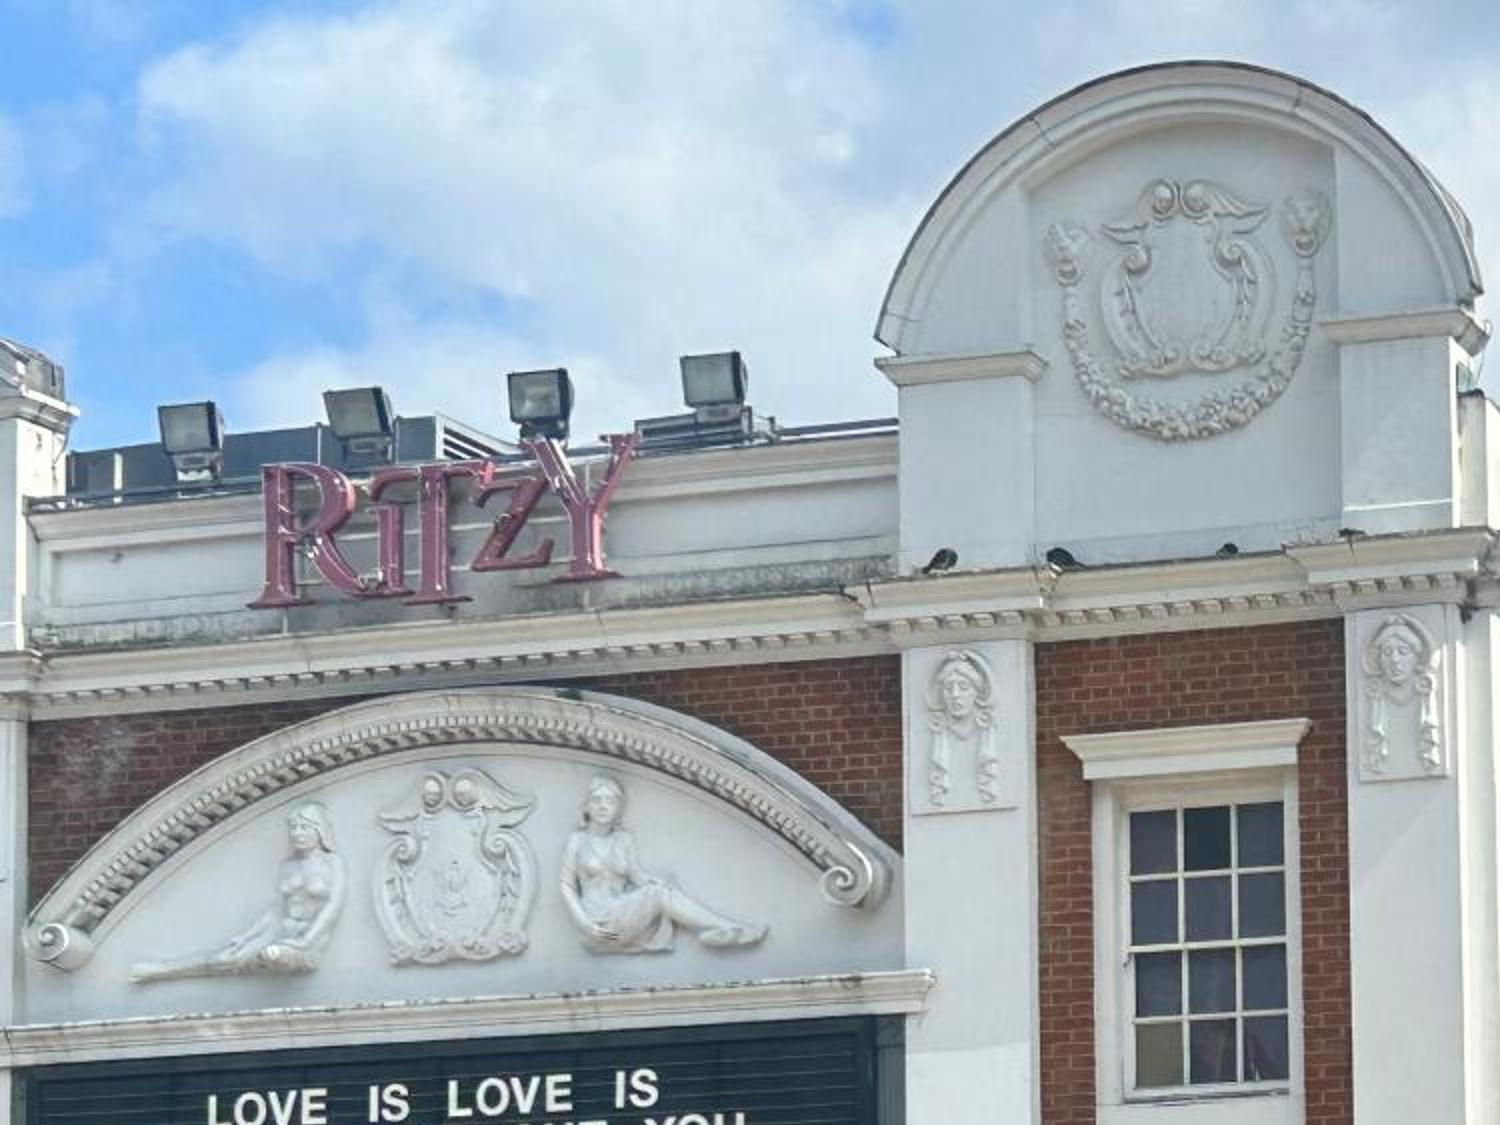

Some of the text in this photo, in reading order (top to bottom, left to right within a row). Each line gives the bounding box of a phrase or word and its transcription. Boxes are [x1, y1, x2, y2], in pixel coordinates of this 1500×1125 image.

[368, 1083, 411, 1123] IS
[447, 1073, 573, 1118] LOVE
[615, 1068, 660, 1109] IS
